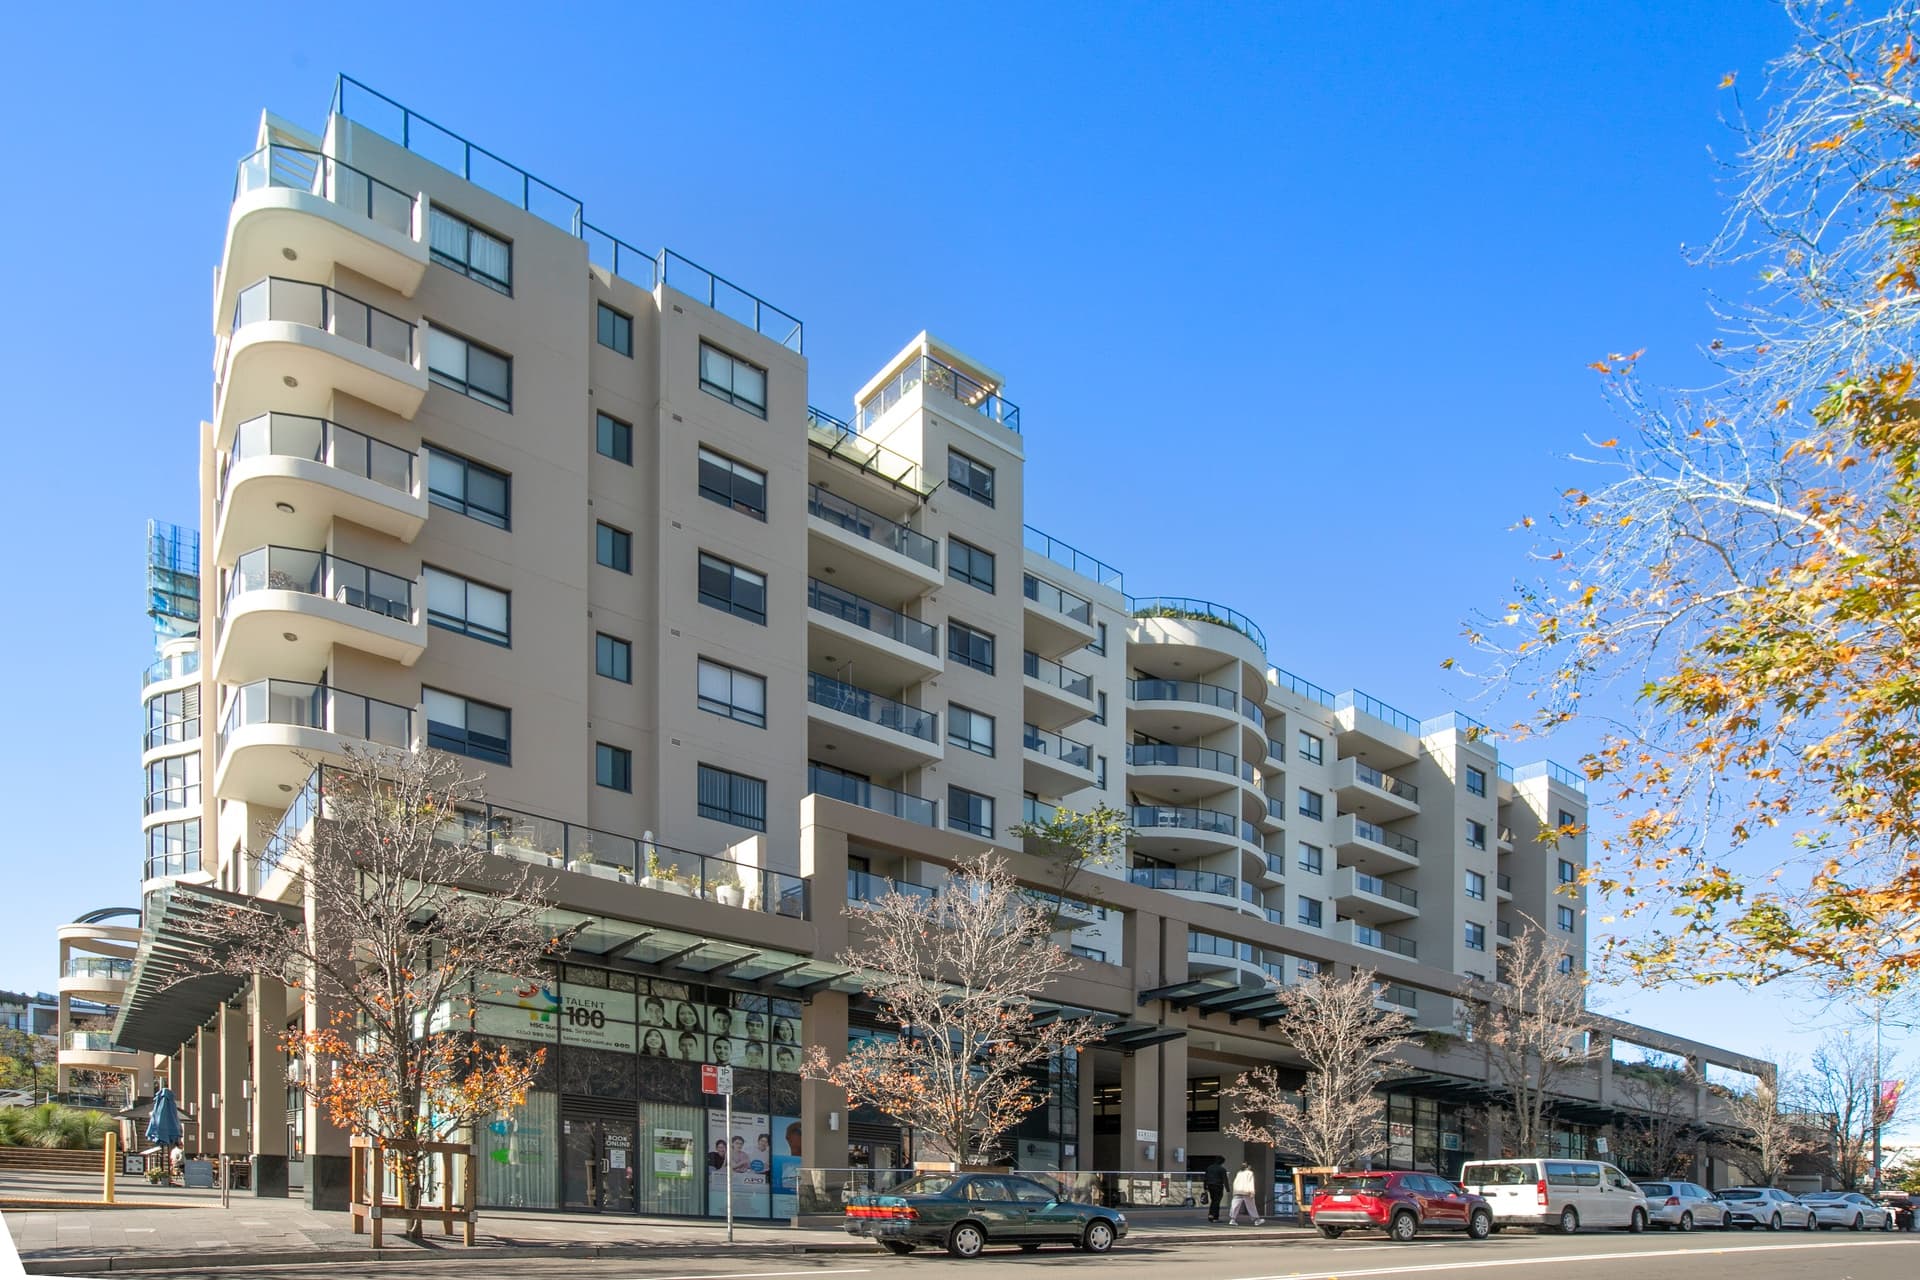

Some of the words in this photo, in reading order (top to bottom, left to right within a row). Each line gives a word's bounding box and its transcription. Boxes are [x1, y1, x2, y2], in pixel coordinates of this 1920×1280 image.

[565, 996, 605, 1009] TALENT
[565, 1006, 605, 1029] 100
[721, 1068, 730, 1076] 1P
